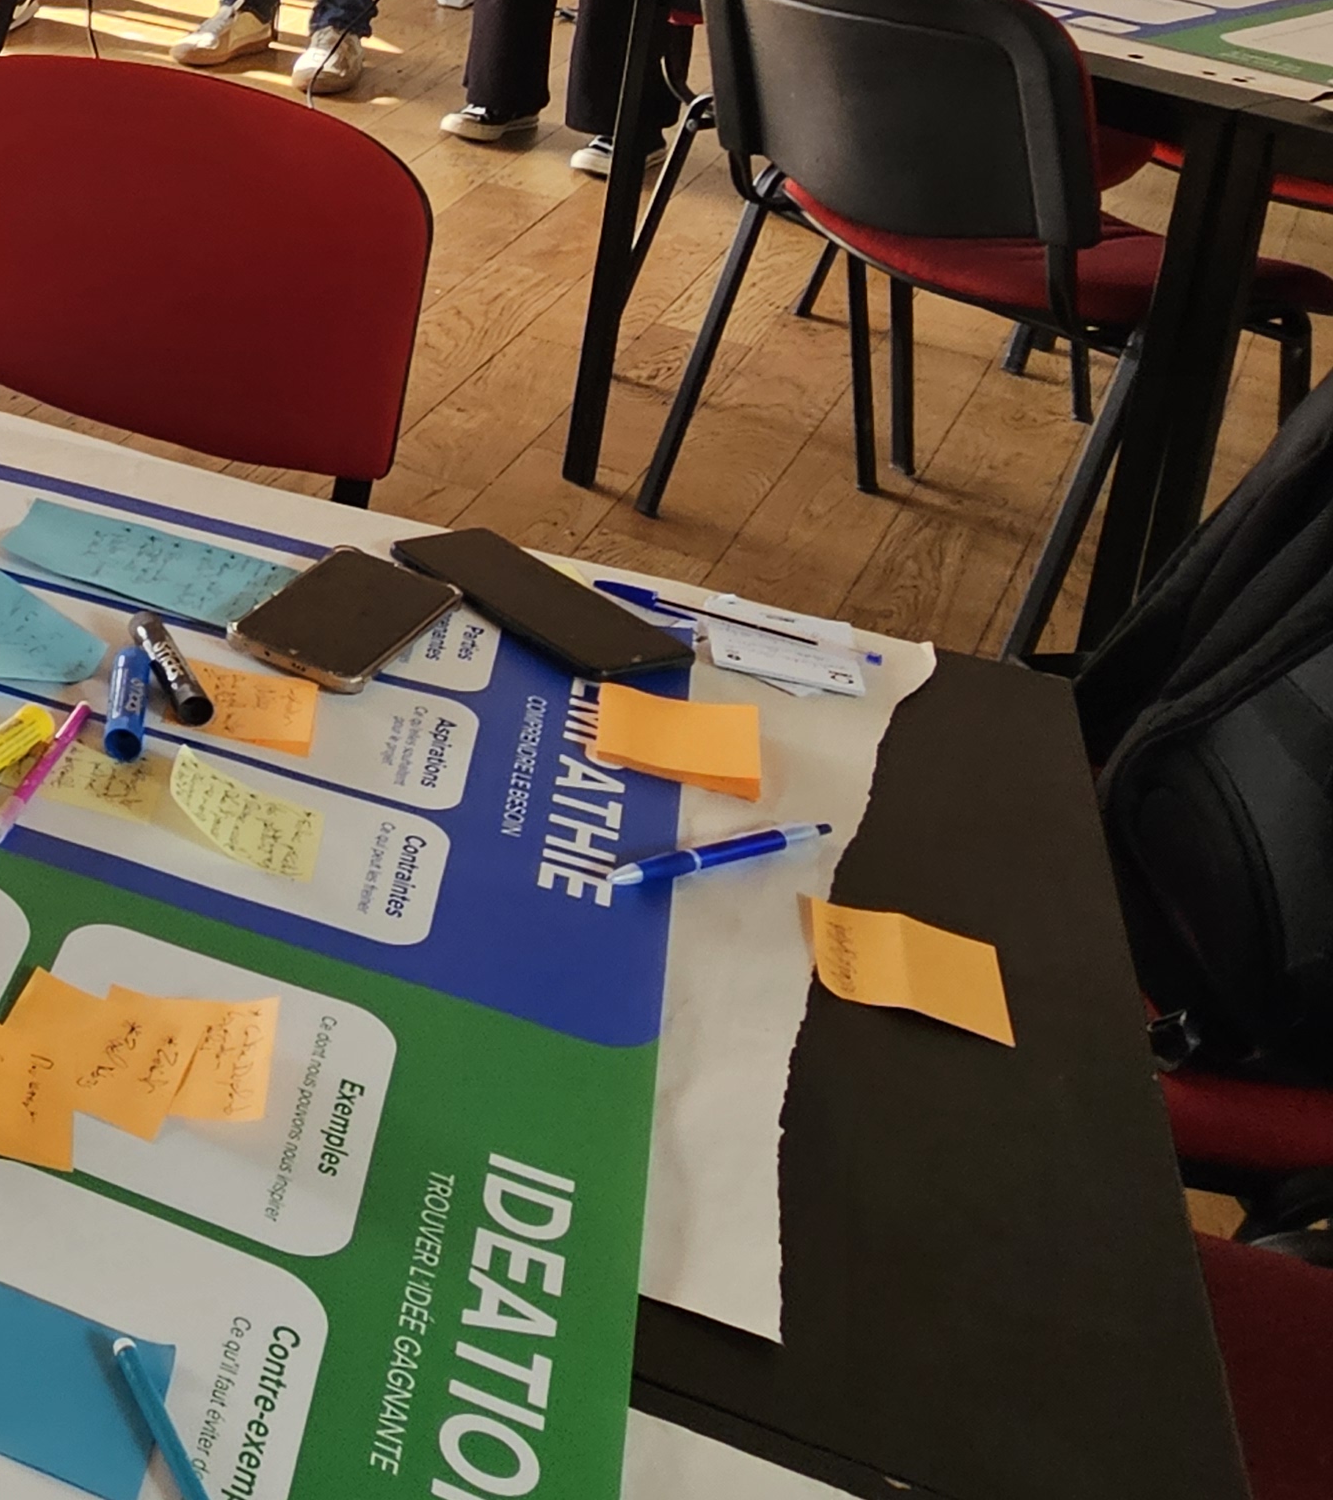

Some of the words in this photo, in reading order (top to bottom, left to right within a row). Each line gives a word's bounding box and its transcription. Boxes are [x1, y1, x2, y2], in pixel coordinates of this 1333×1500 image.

[458, 624, 484, 662] Parties
[420, 716, 458, 789] Aspirations
[514, 695, 548, 772] COMPRENDRE
[510, 768, 532, 790] LE
[380, 821, 396, 835] Ce
[500, 788, 528, 839] BESOIN
[384, 834, 428, 919] Contraintes
[313, 1032, 332, 1056] dont
[320, 1015, 338, 1031] Ce
[304, 1058, 322, 1086] nous
[287, 1086, 312, 1141] pouvons
[317, 1078, 366, 1177] Exemples
[277, 1142, 298, 1182] nous
[263, 1180, 292, 1223] inspirer
[412, 1171, 455, 1268] TROUVER
[399, 1266, 438, 1335] L'IDÉE
[232, 1315, 252, 1340] Ce
[431, 1152, 576, 1500] IDEATIO
[222, 1340, 244, 1375] qu'il
[214, 1375, 235, 1410] faut
[369, 1338, 423, 1477] GAGNANTE
[198, 1409, 221, 1457] éviter
